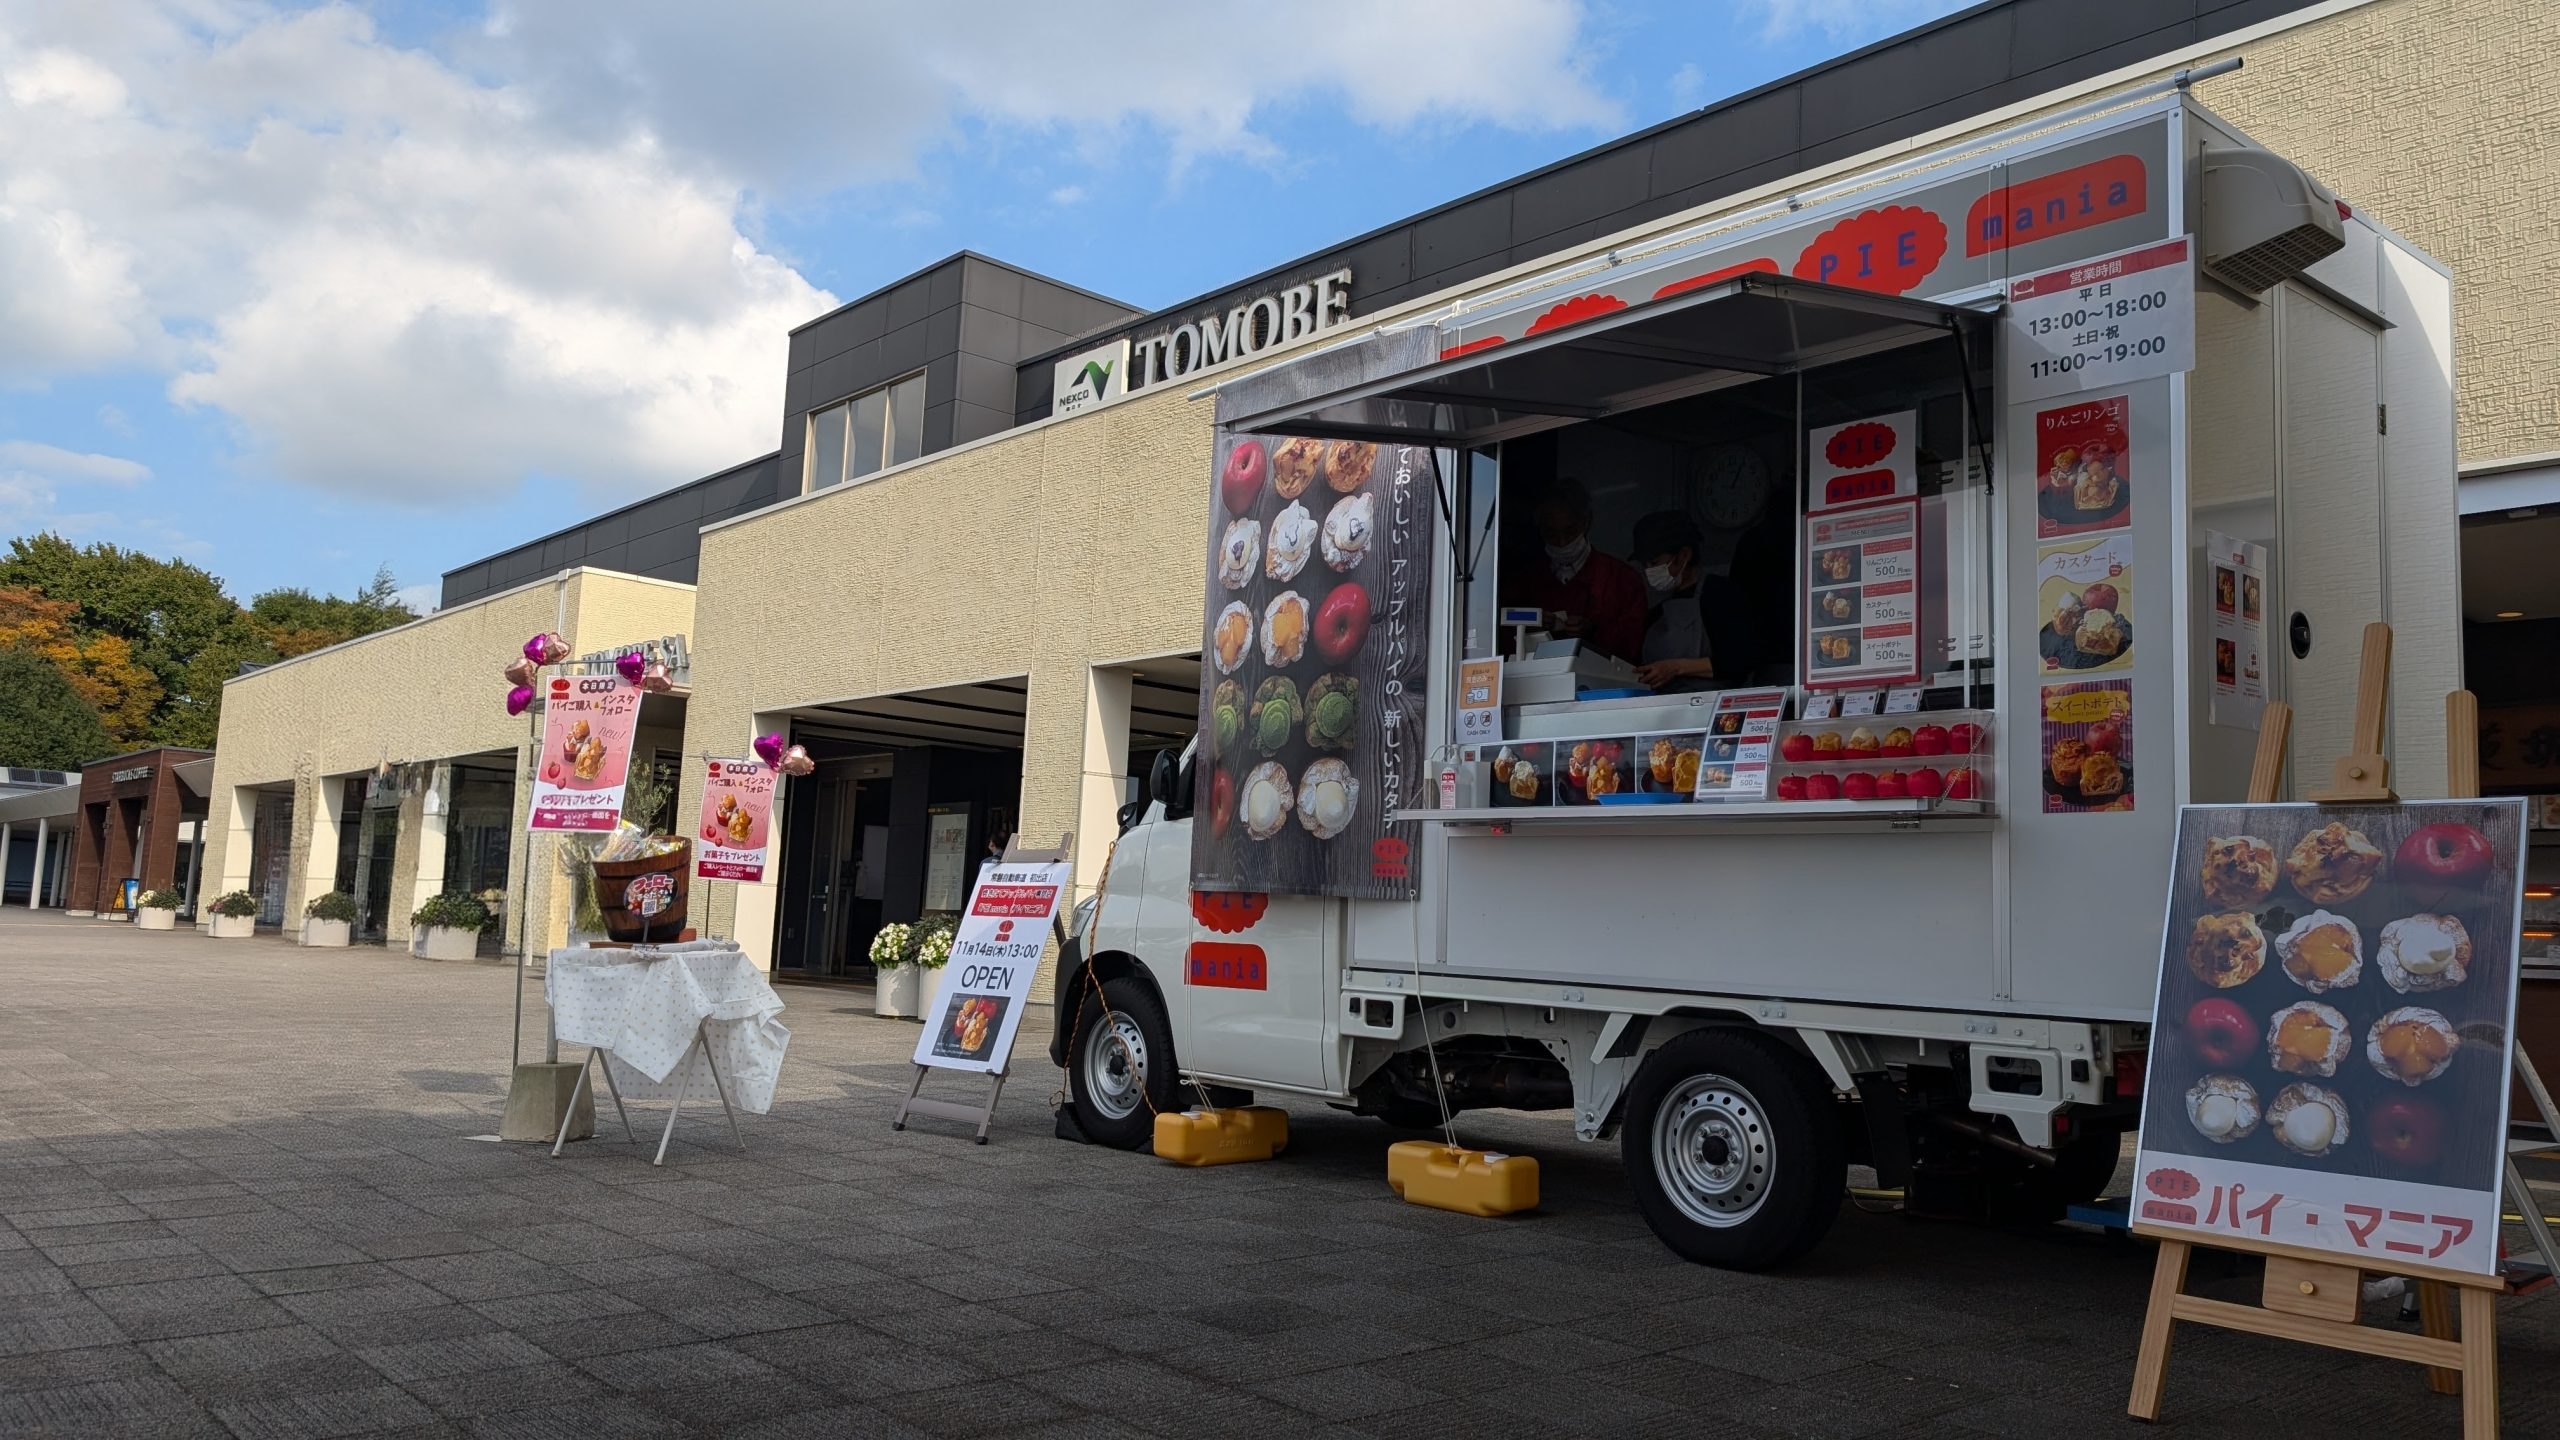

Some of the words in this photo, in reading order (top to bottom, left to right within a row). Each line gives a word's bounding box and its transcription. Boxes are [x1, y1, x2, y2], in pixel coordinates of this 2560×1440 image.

[1982, 179, 2128, 241] mania
[1819, 229, 1917, 283] PIE
[2069, 260, 2122, 285] 営業時間
[1135, 268, 1351, 390] TOMOBE
[2072, 325, 2120, 347] 土日・祝
[1059, 389, 1089, 406] NEXCO
[2046, 403, 2120, 430] りんごリンゴ
[1392, 447, 1411, 545] ておいしい
[1875, 565, 1896, 577] 500
[2055, 552, 2117, 570] カスタード
[1875, 608, 1896, 619] 500
[1385, 559, 1408, 696] アップルパイの
[660, 634, 688, 669] SA
[1875, 650, 1896, 661] 500
[601, 694, 635, 705] インスタ
[2053, 697, 2121, 712] スイートポテト
[600, 706, 632, 716] フォロー
[744, 776, 773, 786] インスタ
[744, 785, 770, 794] フォロー
[961, 964, 1015, 991] OPEN
[1191, 957, 1260, 981] mania
[2155, 1176, 2191, 1191] PIE
[2204, 1183, 2474, 1259] パイ・マニア
